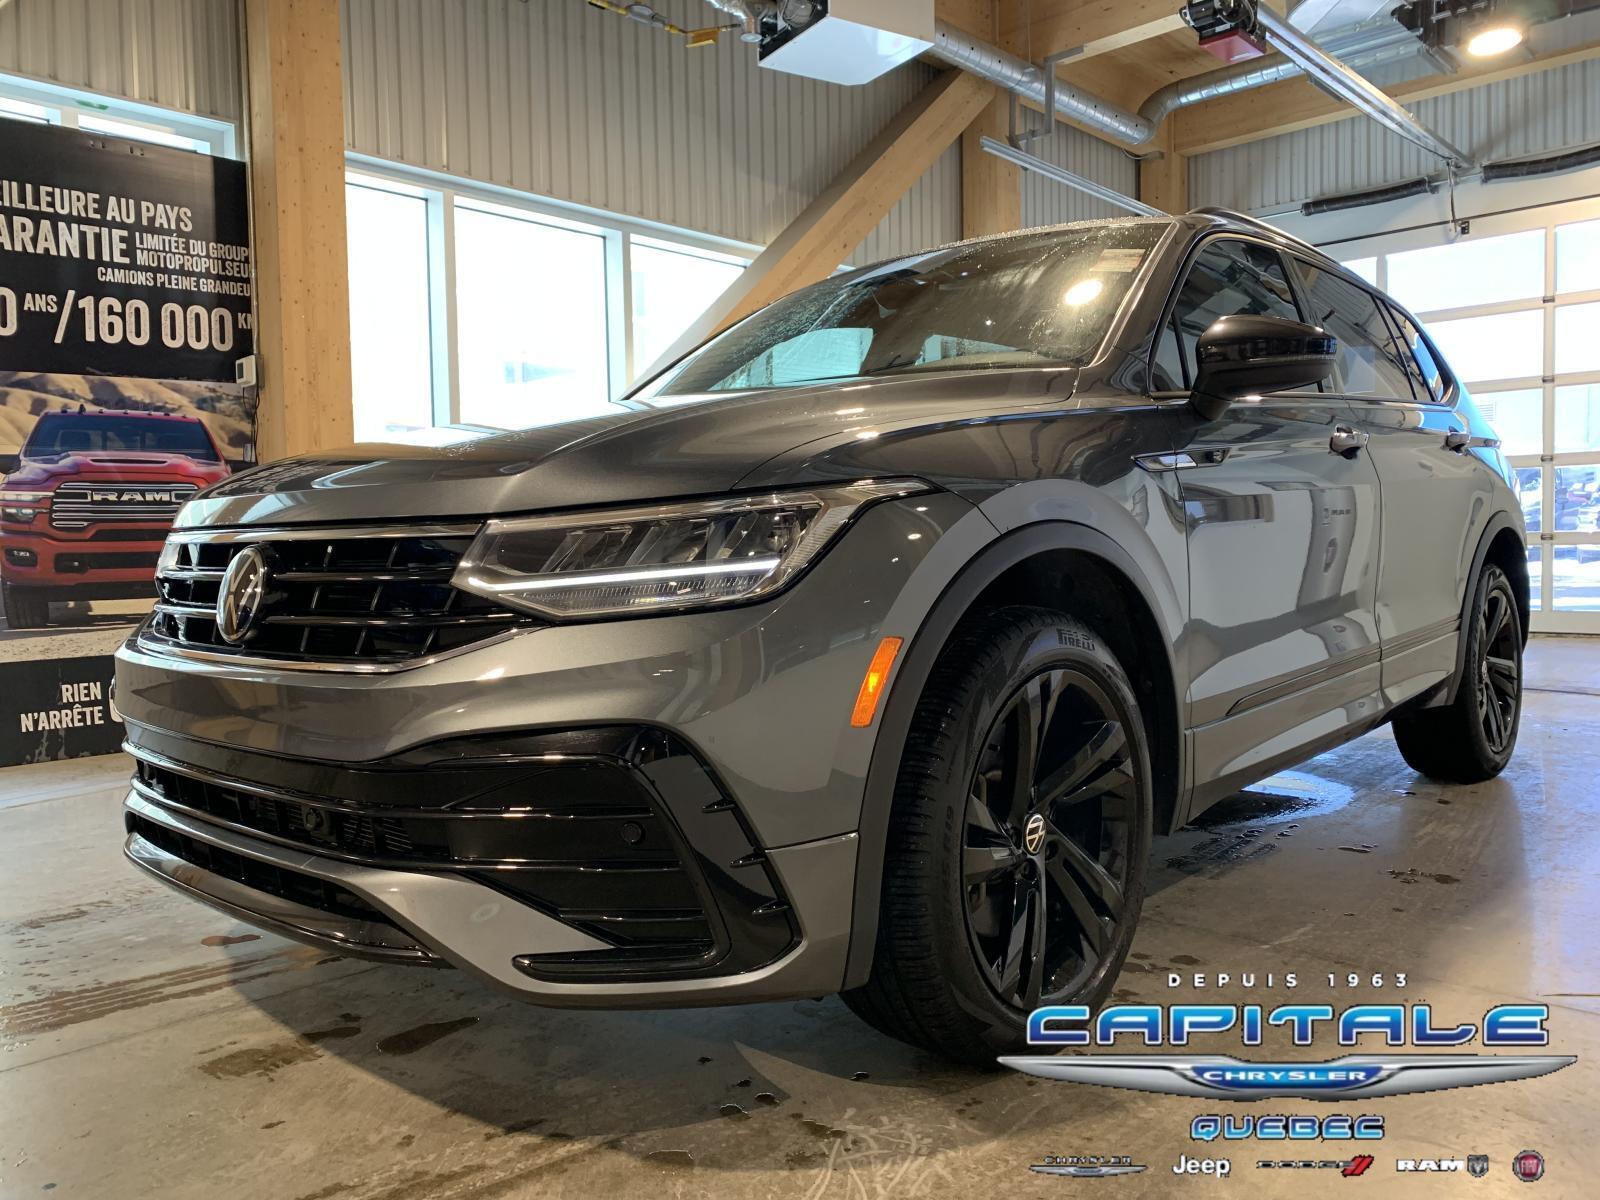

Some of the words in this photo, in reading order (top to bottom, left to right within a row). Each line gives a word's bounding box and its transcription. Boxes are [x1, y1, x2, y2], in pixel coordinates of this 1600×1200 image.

[0, 179, 101, 219] ILLEURE
[106, 195, 135, 224] AU
[141, 201, 193, 232] PAYS
[135, 231, 187, 254] LIMITÉE
[189, 239, 207, 256] DU
[97, 266, 154, 287] CAMIONS
[156, 273, 198, 292] PLEINE
[23, 292, 58, 313] ANS
[161, 302, 234, 352] 000
[92, 491, 171, 502] RAM
[1056, 628, 1096, 651] PIRELLI
[61, 681, 102, 703] RIEN
[20, 703, 104, 733] N'ARRÊTE
